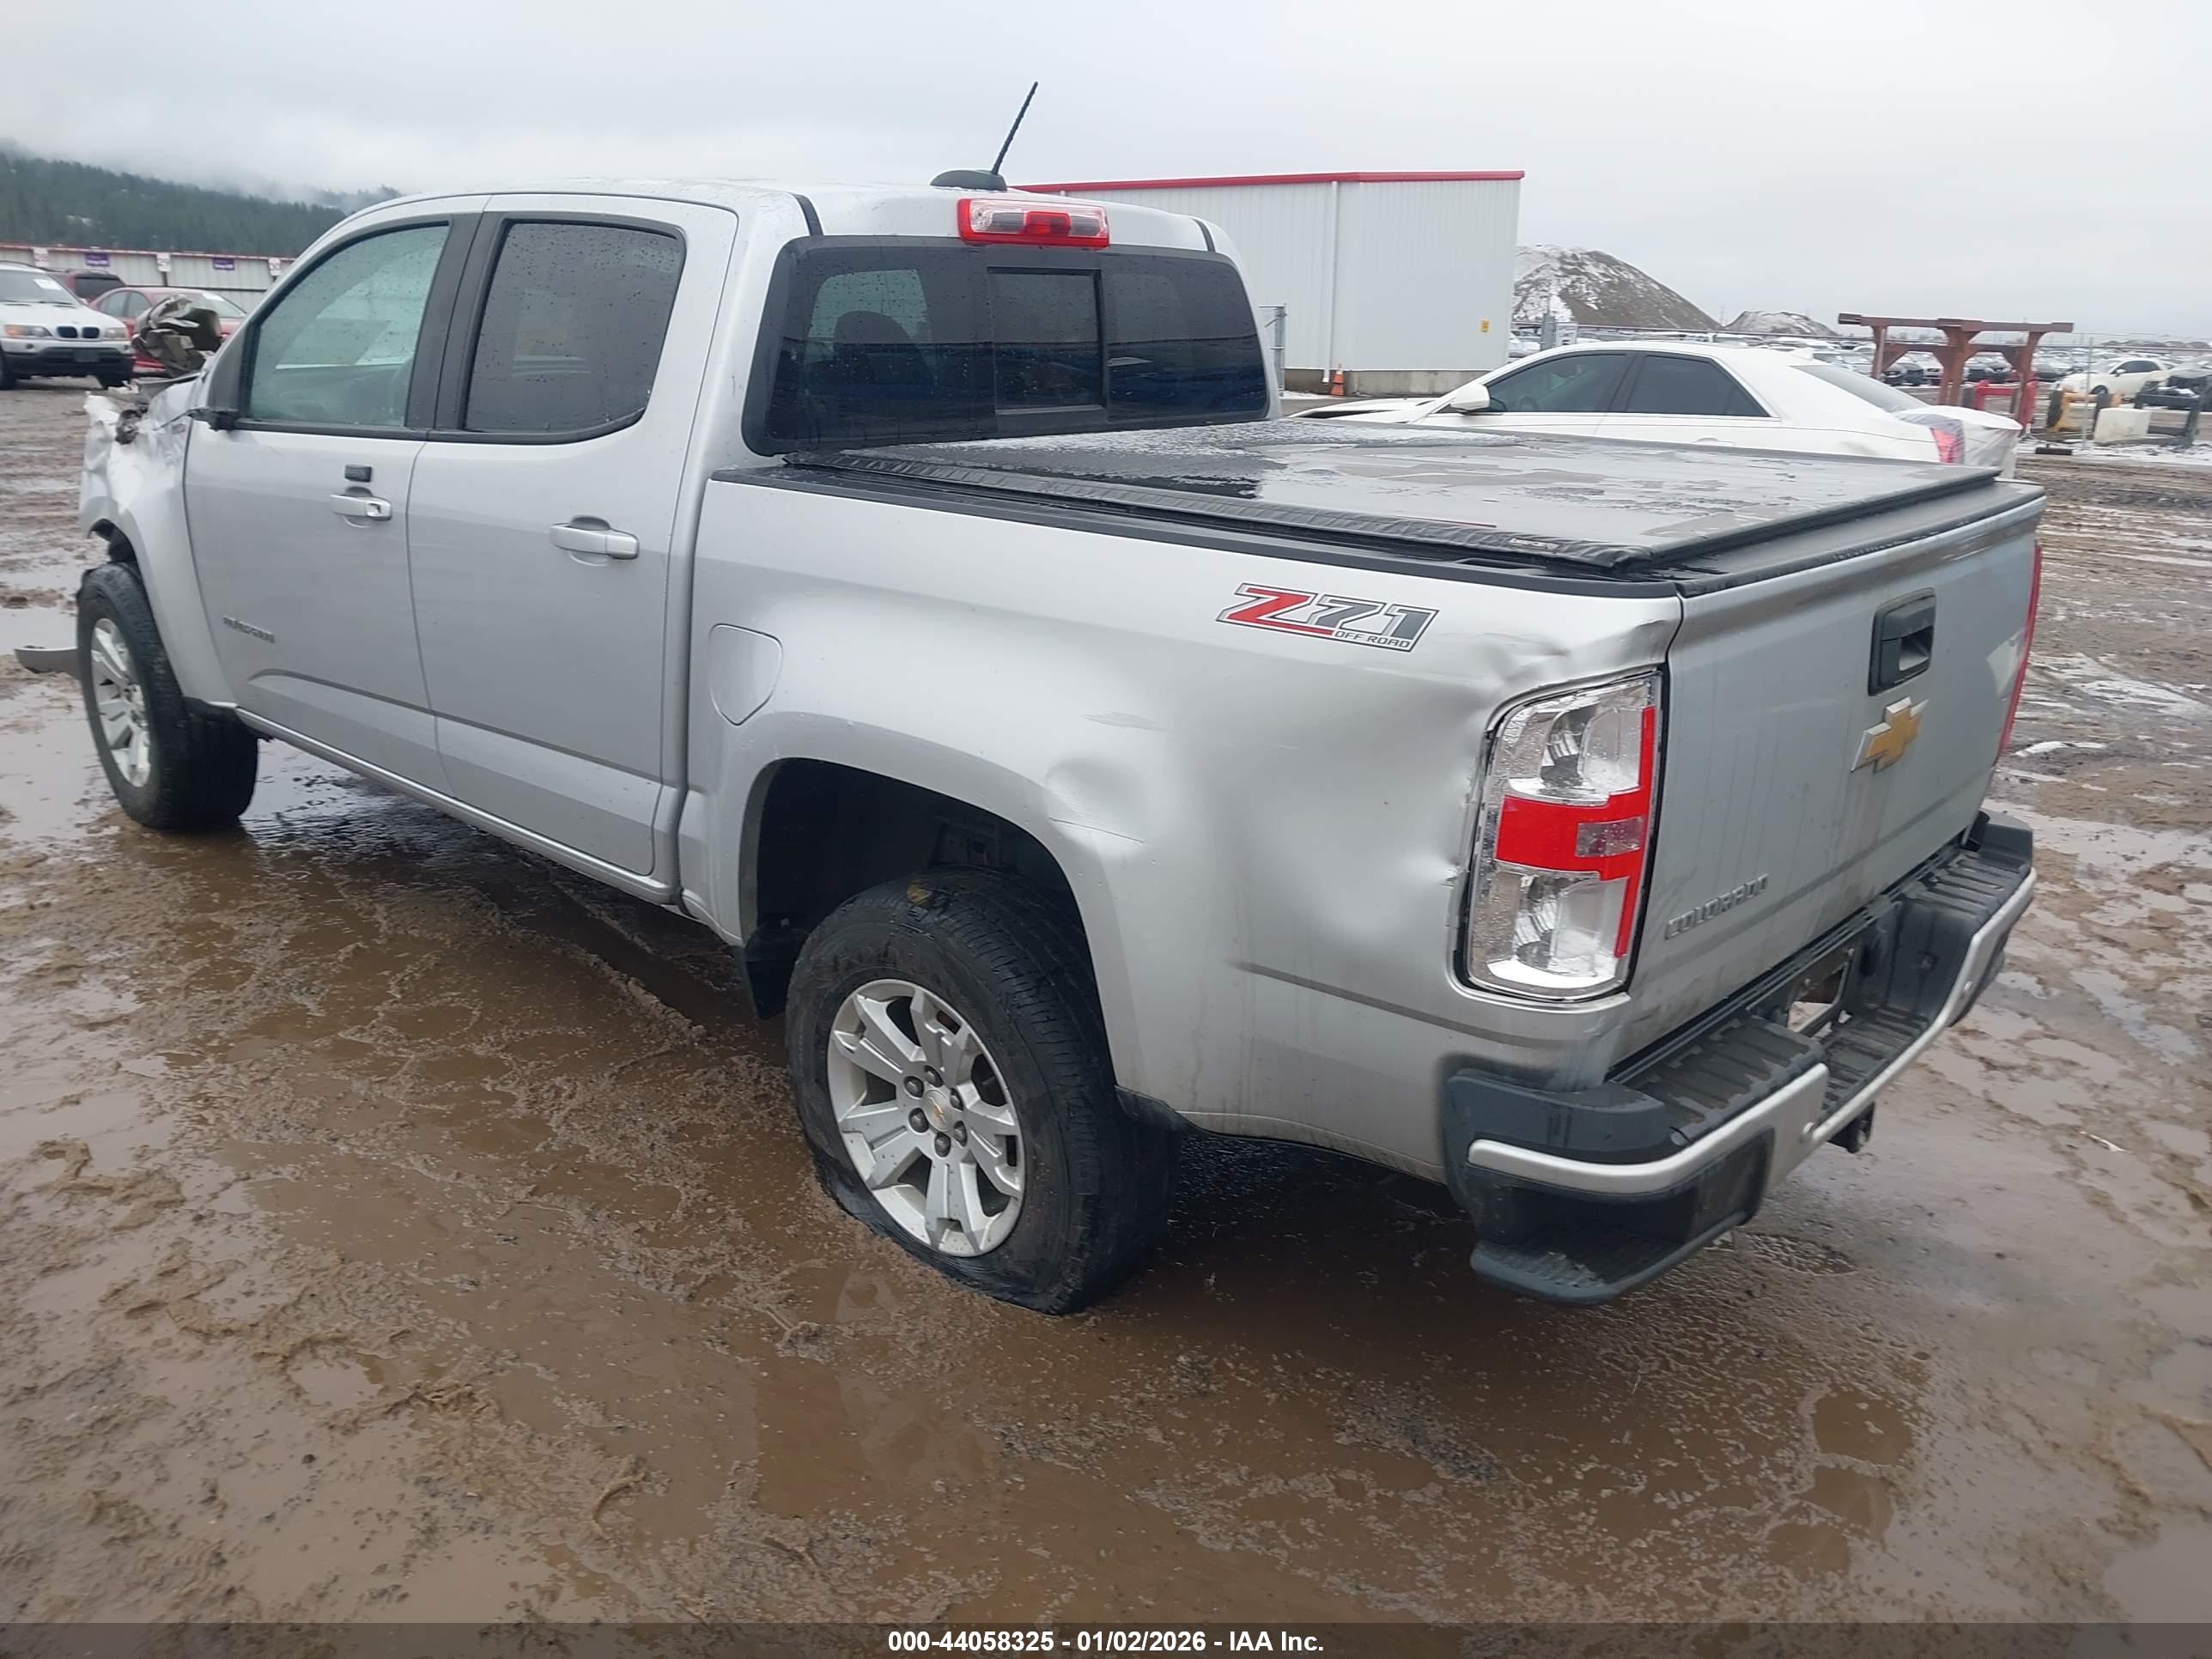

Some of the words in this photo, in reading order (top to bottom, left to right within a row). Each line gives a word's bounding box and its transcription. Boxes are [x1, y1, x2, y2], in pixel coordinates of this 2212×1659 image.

[1216, 582, 1439, 642] Z71
[1334, 630, 1364, 640] OFF
[1367, 635, 1410, 647] ROAD
